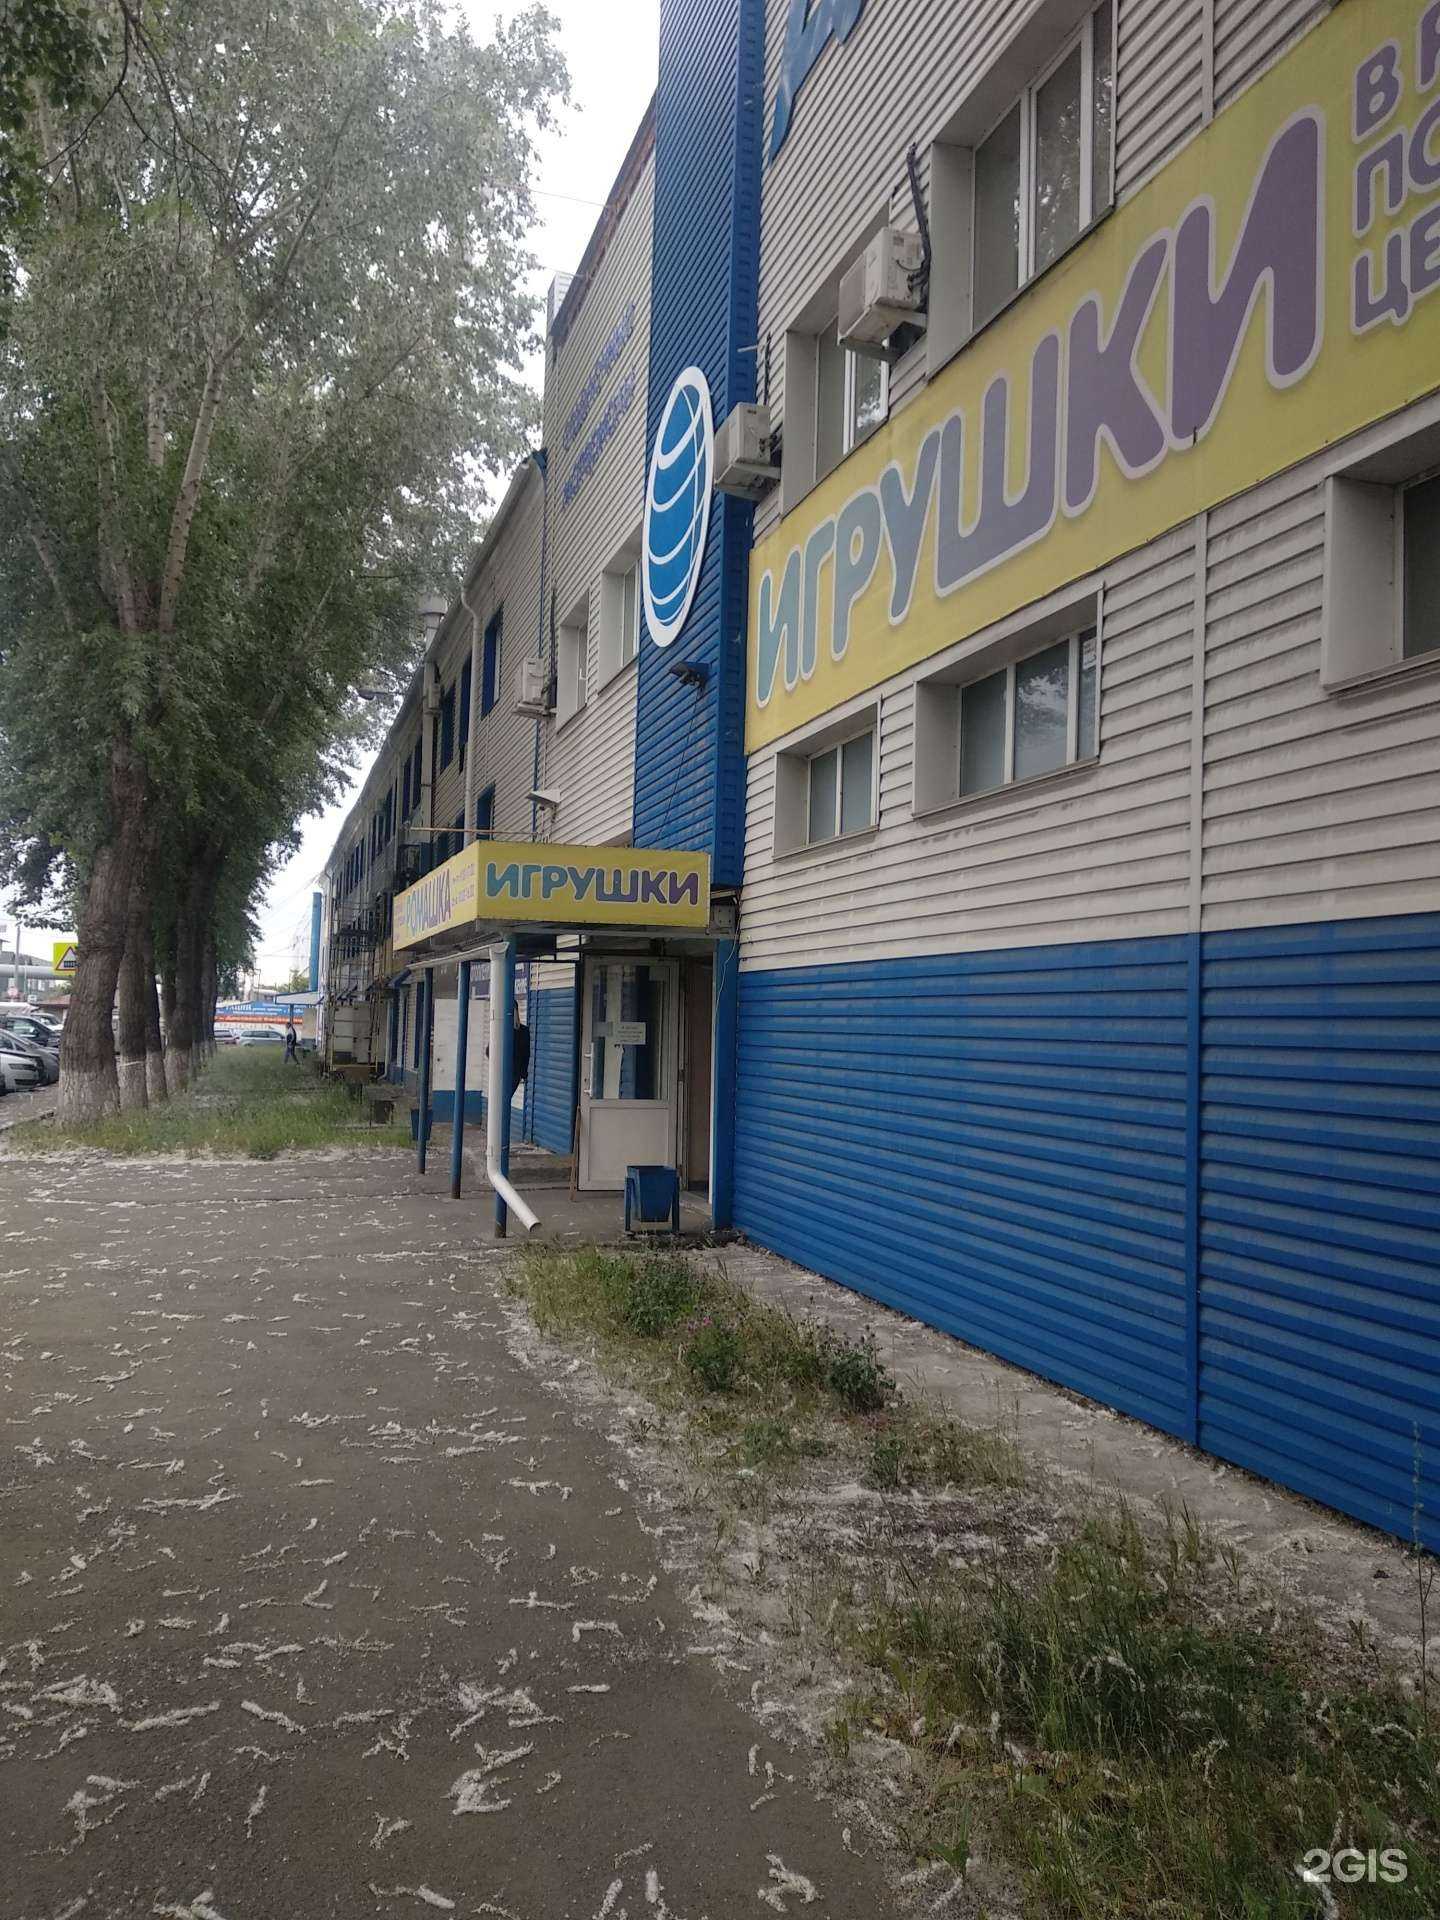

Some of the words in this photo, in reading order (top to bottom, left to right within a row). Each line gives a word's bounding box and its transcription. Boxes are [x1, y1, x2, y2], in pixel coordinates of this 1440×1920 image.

[1354, 42, 1401, 140] В
[757, 107, 1325, 707] ИГРУШКИ
[486, 862, 700, 906] ИГРУШКИ
